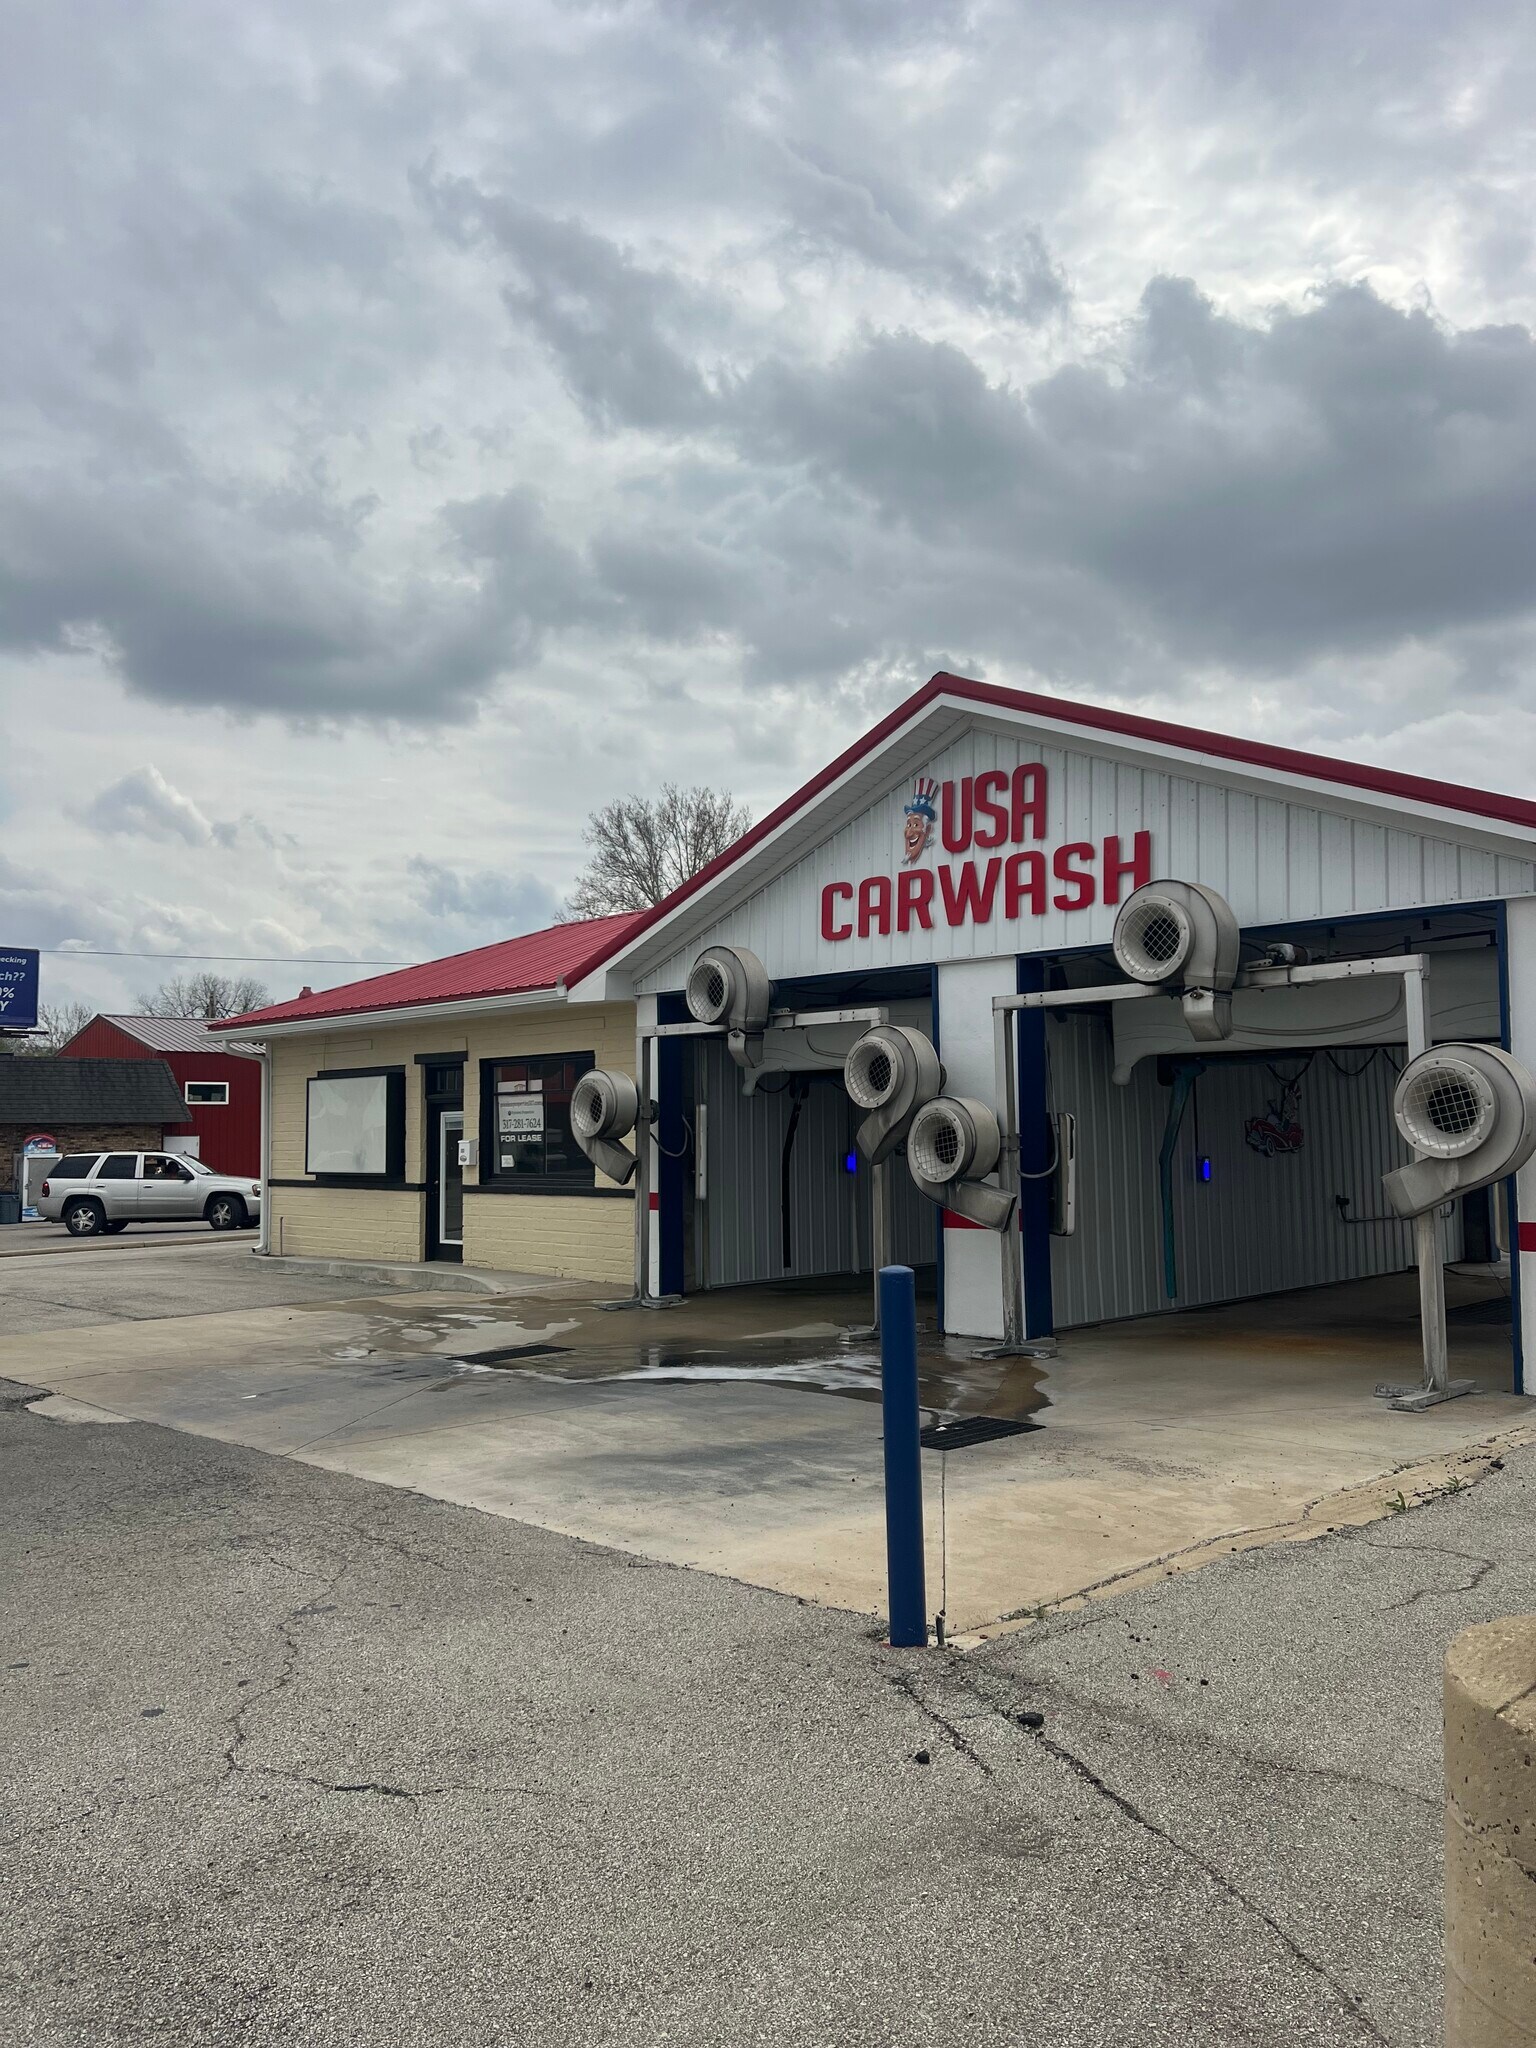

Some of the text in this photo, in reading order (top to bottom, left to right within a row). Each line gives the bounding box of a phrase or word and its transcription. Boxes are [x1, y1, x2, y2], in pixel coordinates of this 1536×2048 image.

[942, 762, 1048, 853] USA
[821, 830, 1151, 941] CARWASH
[0, 956, 27, 965] ecking
[502, 1118, 541, 1129] 317-281-7624
[518, 1134, 542, 1142] LEASE
